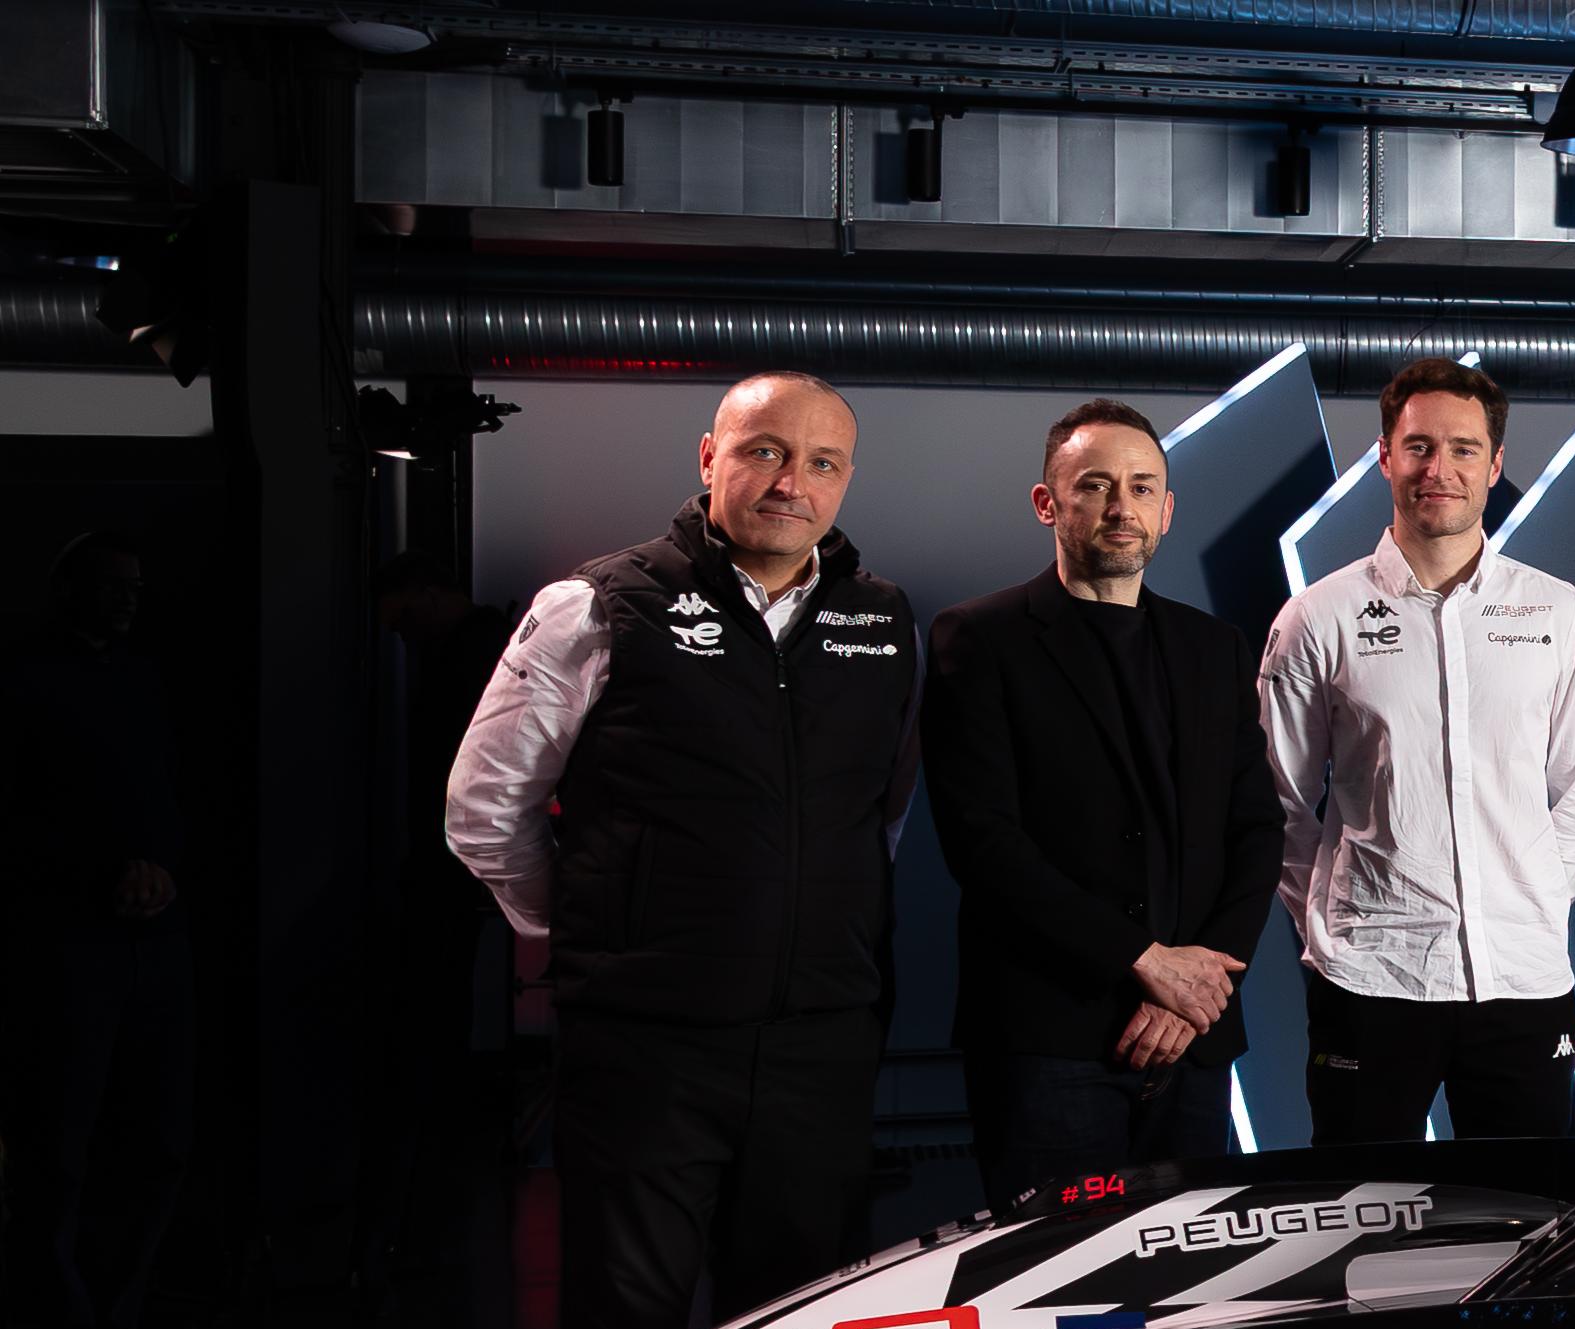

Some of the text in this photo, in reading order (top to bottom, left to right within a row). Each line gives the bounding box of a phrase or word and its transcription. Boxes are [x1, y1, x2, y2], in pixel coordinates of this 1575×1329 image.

[1496, 604, 1554, 613] PEUGEOT
[832, 612, 893, 622] PEUGEOT
[1494, 610, 1533, 618] SPORT
[830, 618, 873, 626] SPORT
[1487, 632, 1542, 647] Capgemini
[823, 639, 883, 657] Capgemini
[1358, 648, 1404, 658] TotalEnergies
[1061, 1175, 1125, 1203] #94
[1139, 1199, 1430, 1252] PEUGEOT
